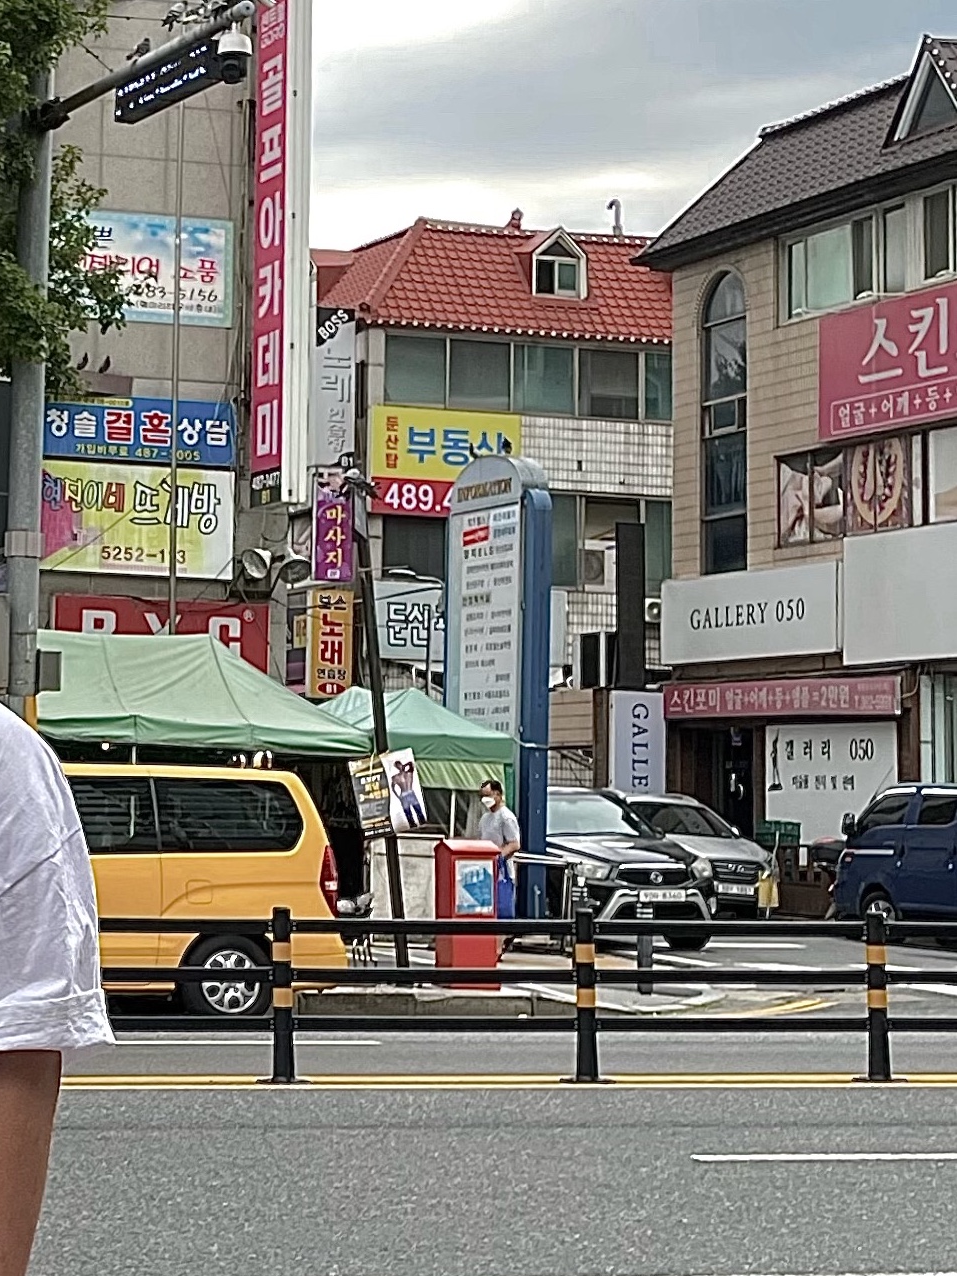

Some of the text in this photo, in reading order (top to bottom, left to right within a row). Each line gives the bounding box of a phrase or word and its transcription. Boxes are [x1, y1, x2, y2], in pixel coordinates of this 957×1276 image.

[317, 309, 349, 340] BOSS
[858, 297, 957, 384] 스킨
[324, 504, 346, 568] 마사지
[101, 546, 186, 564] 5252-13
[690, 598, 805, 630] GALLERY 050
[320, 613, 343, 665] 노래
[669, 687, 720, 713] 스킨포미
[632, 703, 650, 794] GALLE
[850, 738, 875, 760] 050
